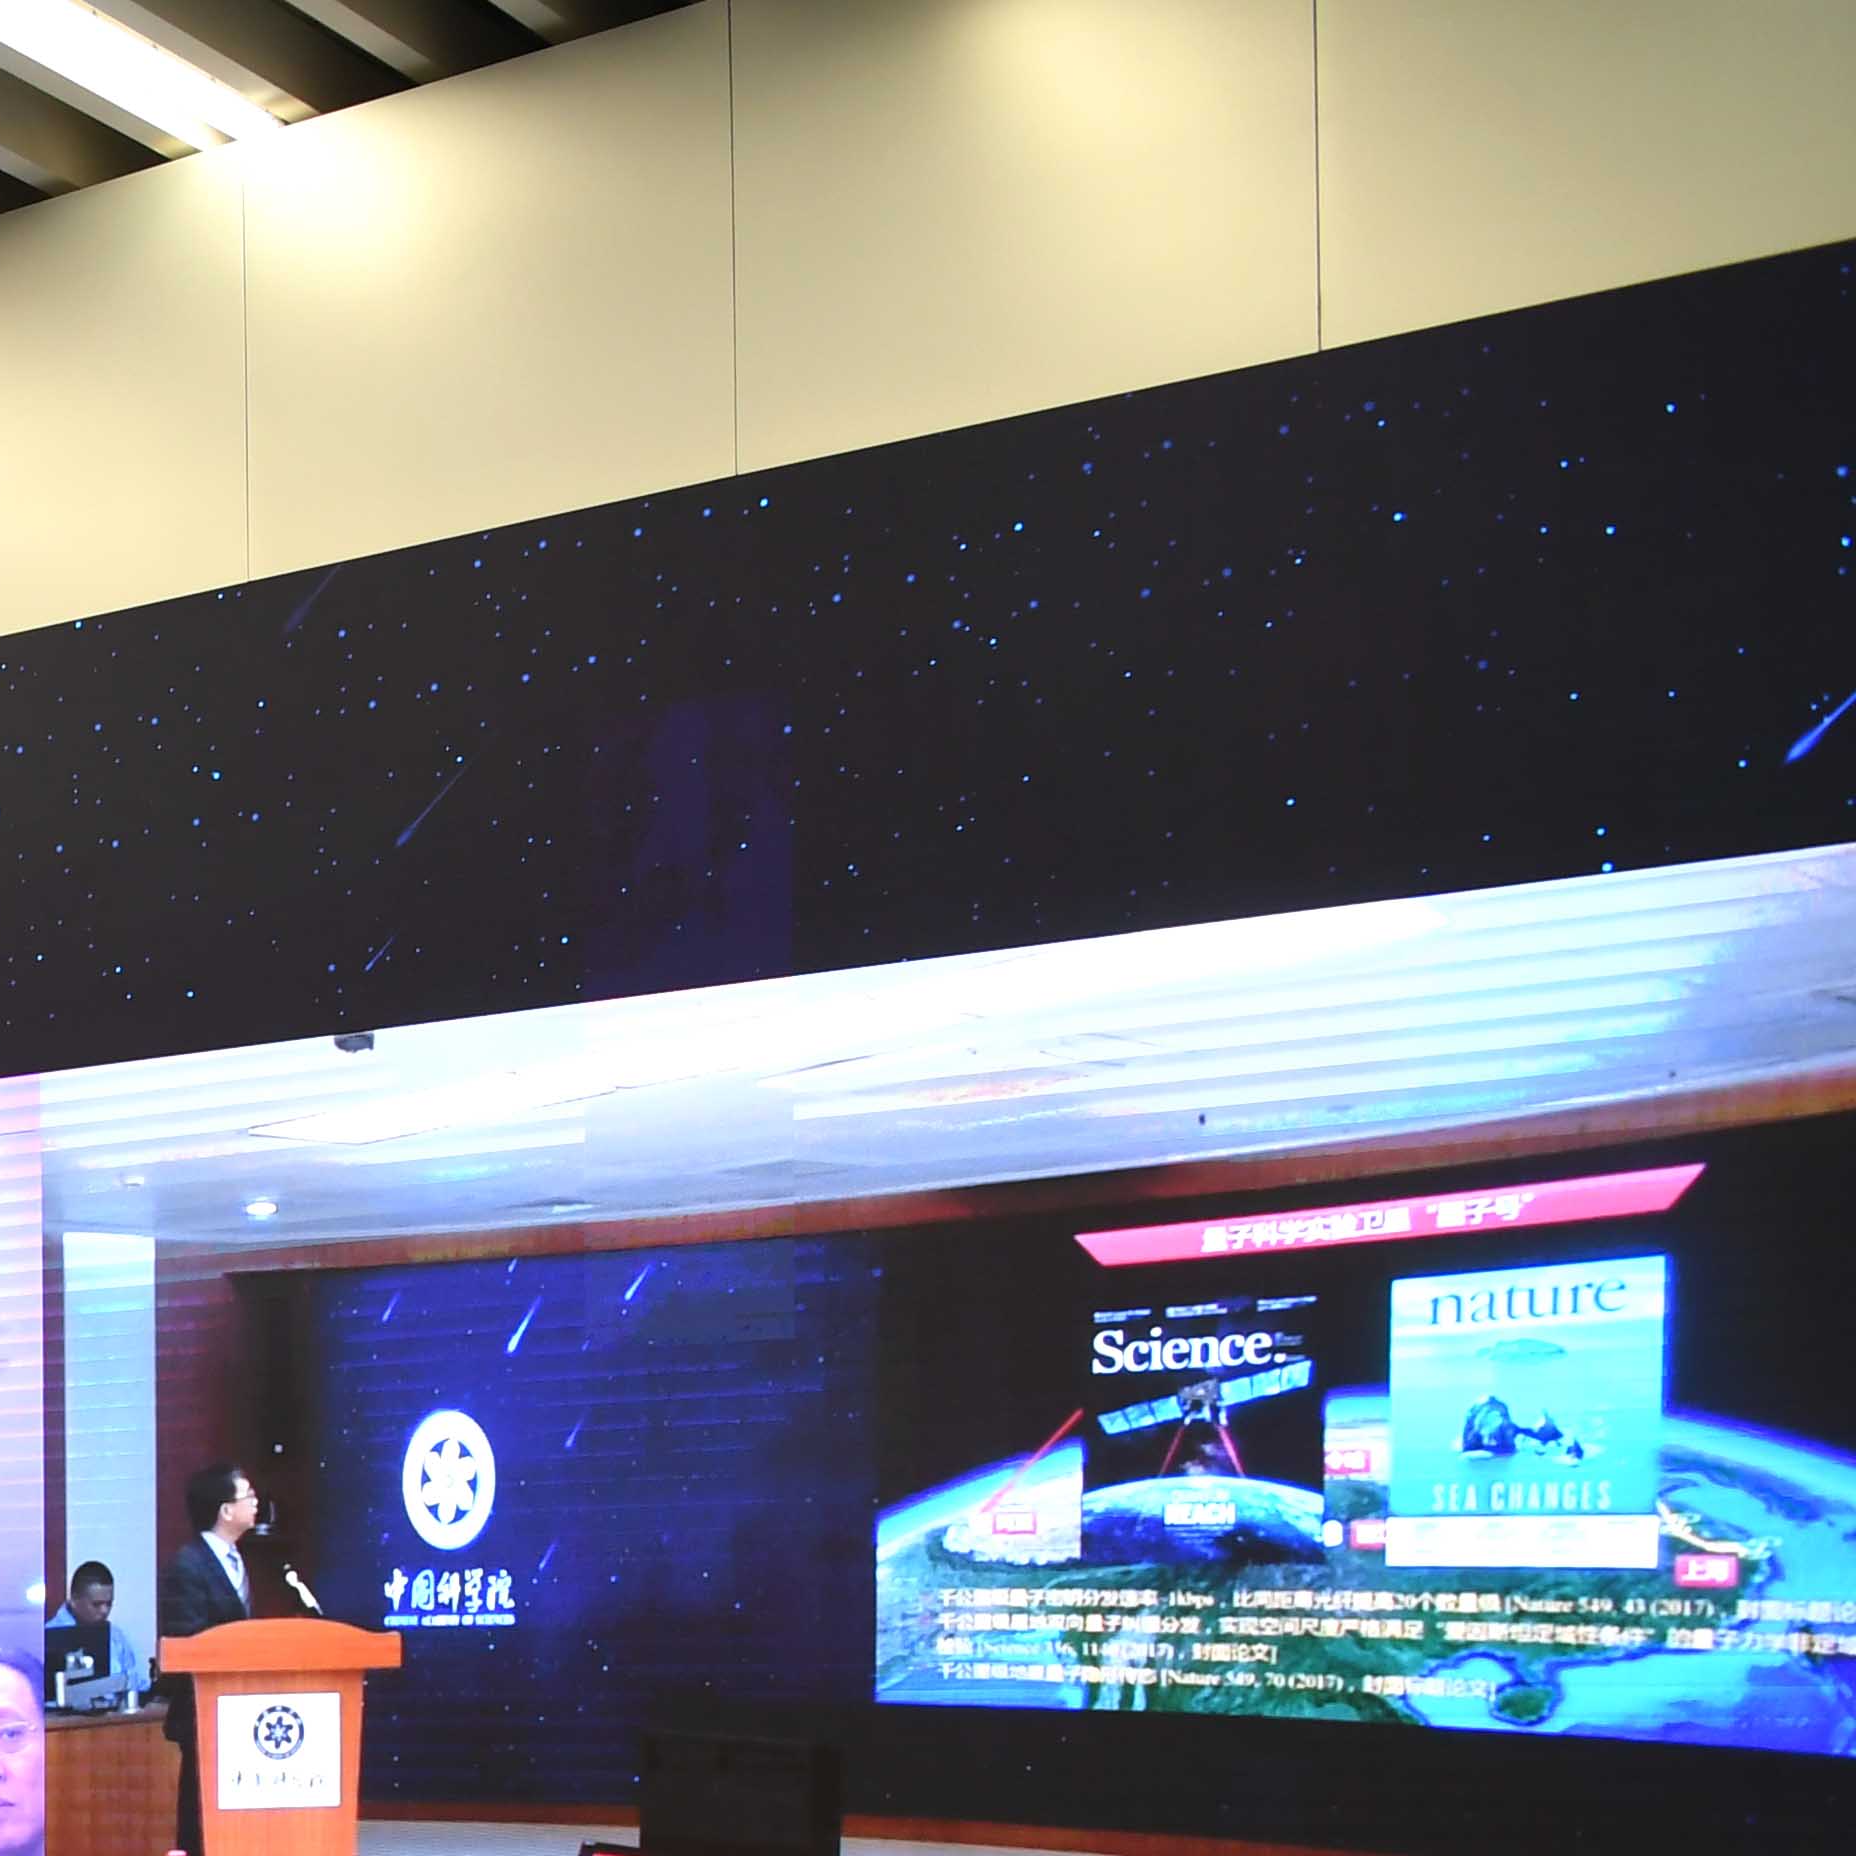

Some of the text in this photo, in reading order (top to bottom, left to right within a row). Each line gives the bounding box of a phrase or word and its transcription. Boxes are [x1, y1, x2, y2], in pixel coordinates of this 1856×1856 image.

[1430, 1270, 1627, 1328] nature
[1431, 1479, 1613, 1512] SEA CHANGES
[384, 1567, 516, 1614] 中国科学院
